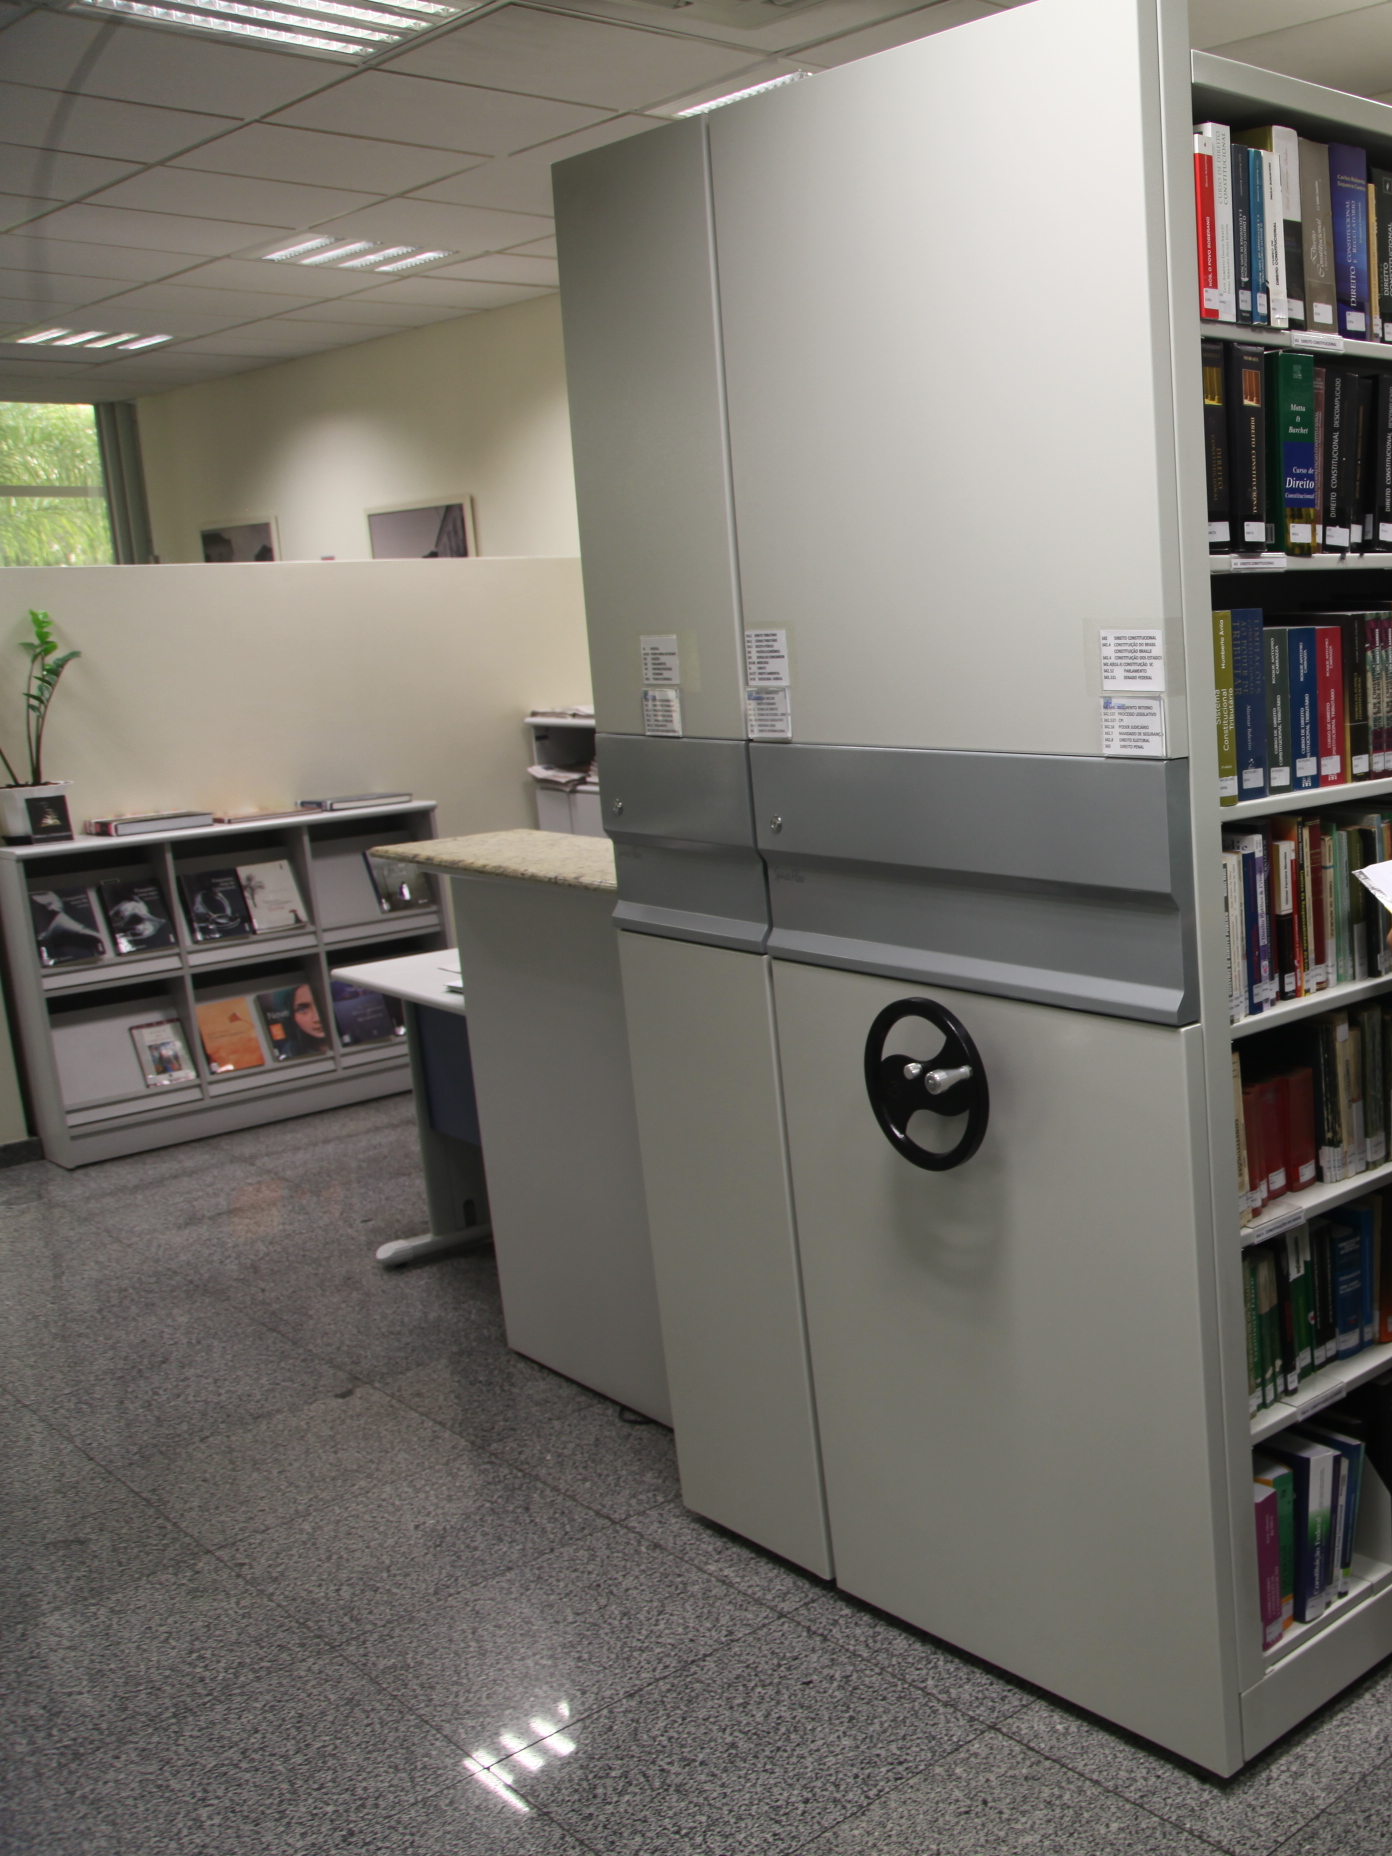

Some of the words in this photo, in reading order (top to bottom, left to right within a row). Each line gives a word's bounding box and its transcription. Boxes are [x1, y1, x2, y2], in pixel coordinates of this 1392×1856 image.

[1217, 169, 1222, 182] DE
[1337, 174, 1351, 182] Carlos
[1337, 181, 1356, 189] Siqueira
[1316, 218, 1325, 278] Constitucional
[1290, 403, 1306, 412] Motta
[1333, 377, 1341, 428] DESCOMPLICADO
[1288, 426, 1309, 434] Barchet
[1292, 466, 1307, 474] Curso
[1331, 431, 1339, 489] CONSTITUCIONAL
[1384, 432, 1392, 485] CONSTITUCIONAL
[1286, 477, 1315, 489] Direito
[1241, 621, 1248, 637] AO
[1232, 621, 1242, 696] TRIBUTAR
[1214, 689, 1222, 725] Sistema
[1221, 688, 1230, 751] Constitucional
[1235, 1118, 1243, 1178] CONSTITUIÇÕES
[1314, 1517, 1322, 1546] Federal
[1313, 1547, 1322, 1595] Constituição
